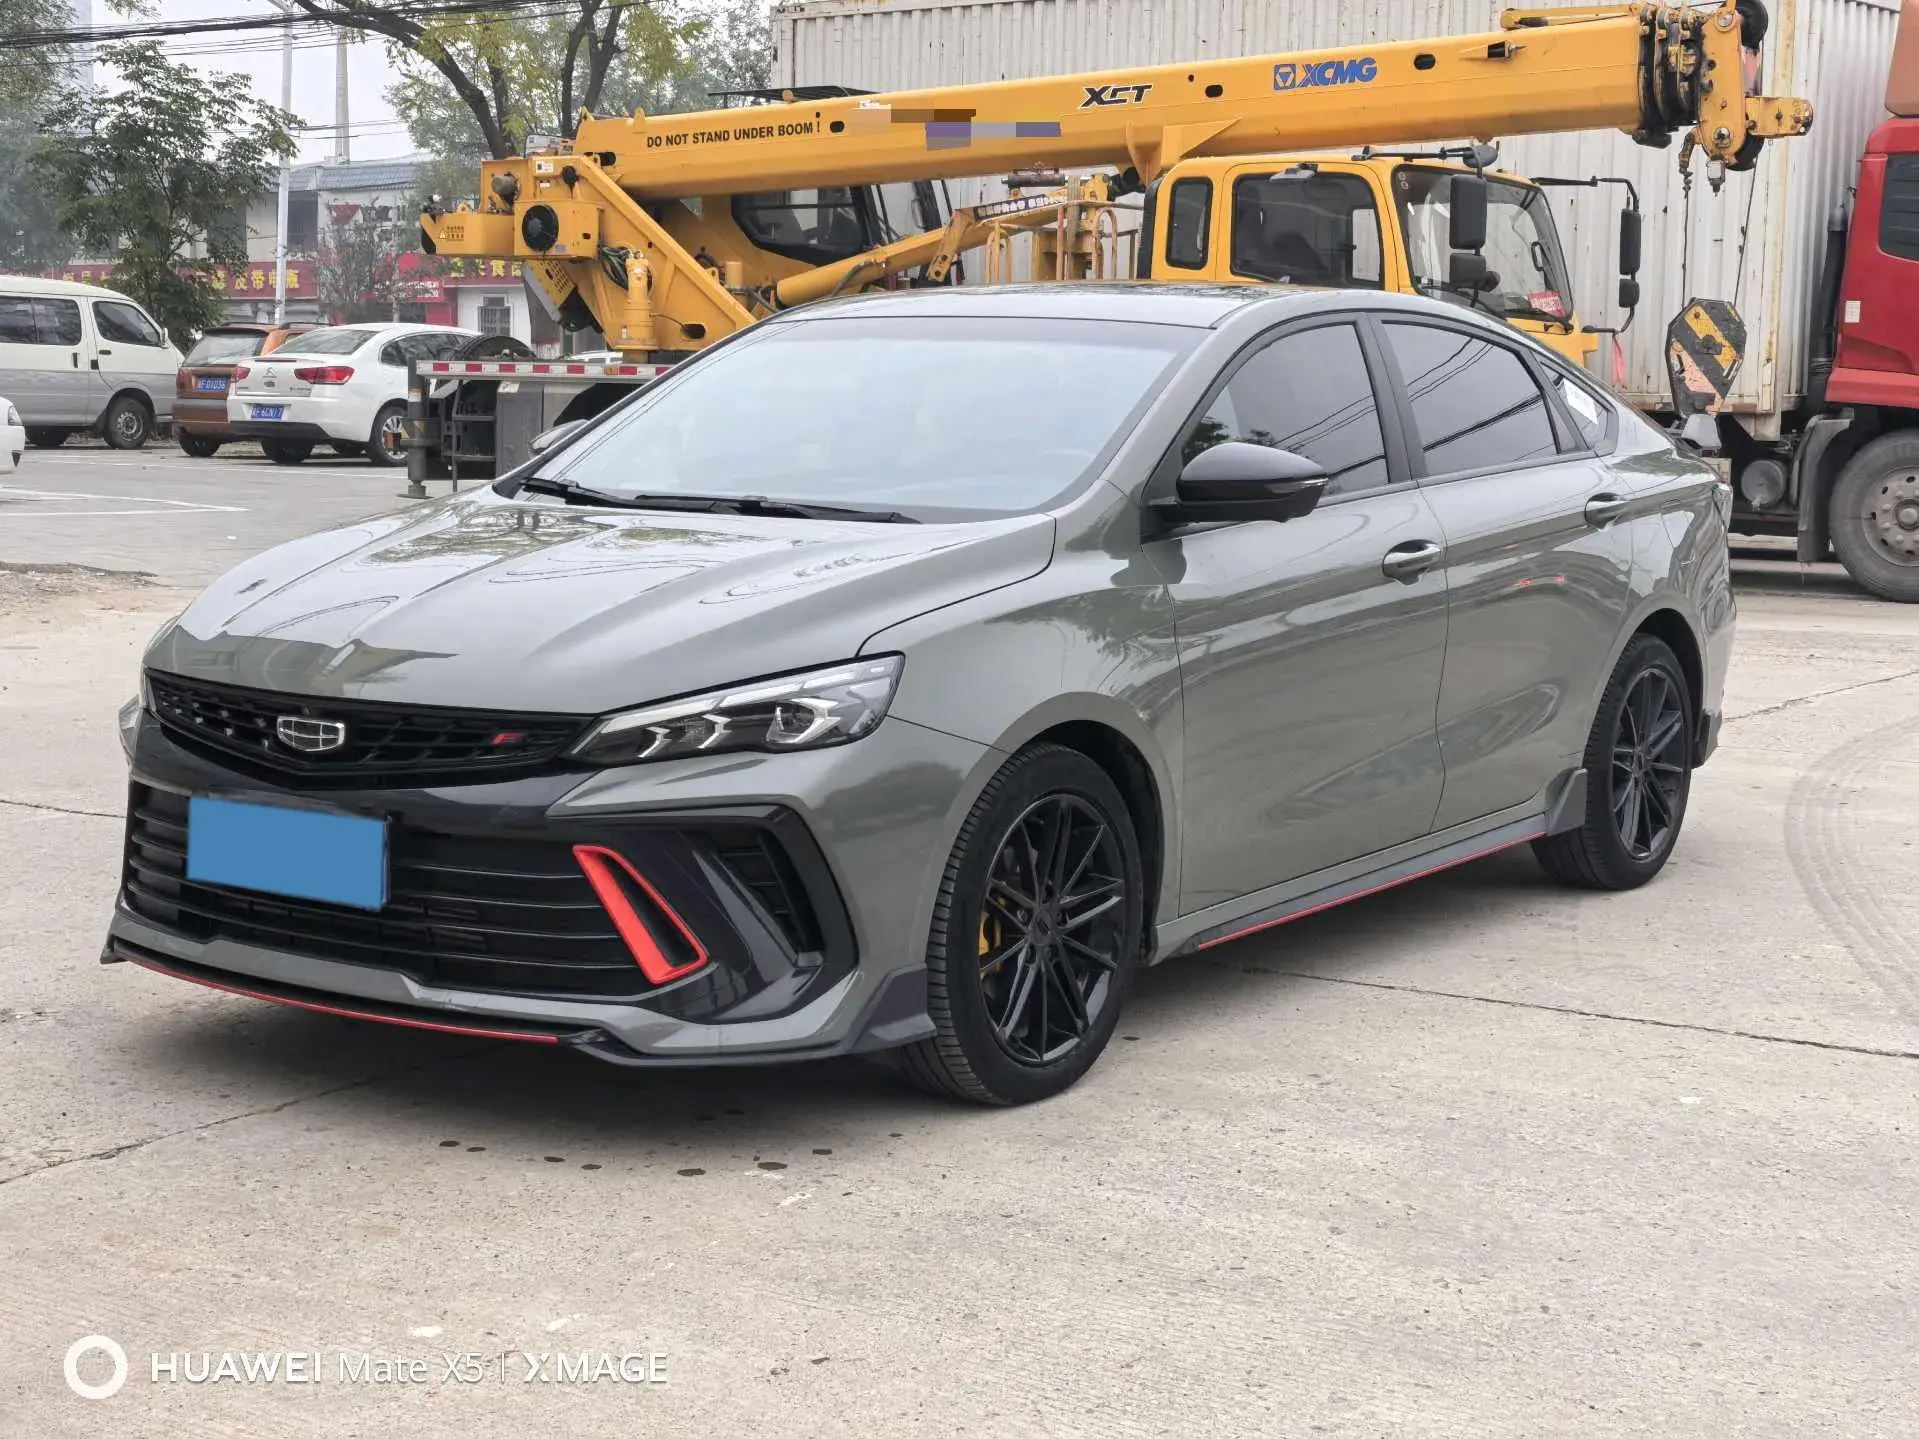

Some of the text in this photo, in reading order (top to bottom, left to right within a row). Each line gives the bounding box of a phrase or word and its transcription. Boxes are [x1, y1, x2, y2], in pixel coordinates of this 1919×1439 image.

[1299, 57, 1378, 88] XCMG
[647, 135, 662, 148] DO
[665, 133, 689, 147] NOT
[692, 129, 730, 144] STAND
[733, 126, 774, 141] UNDER
[778, 122, 813, 136] BOOM
